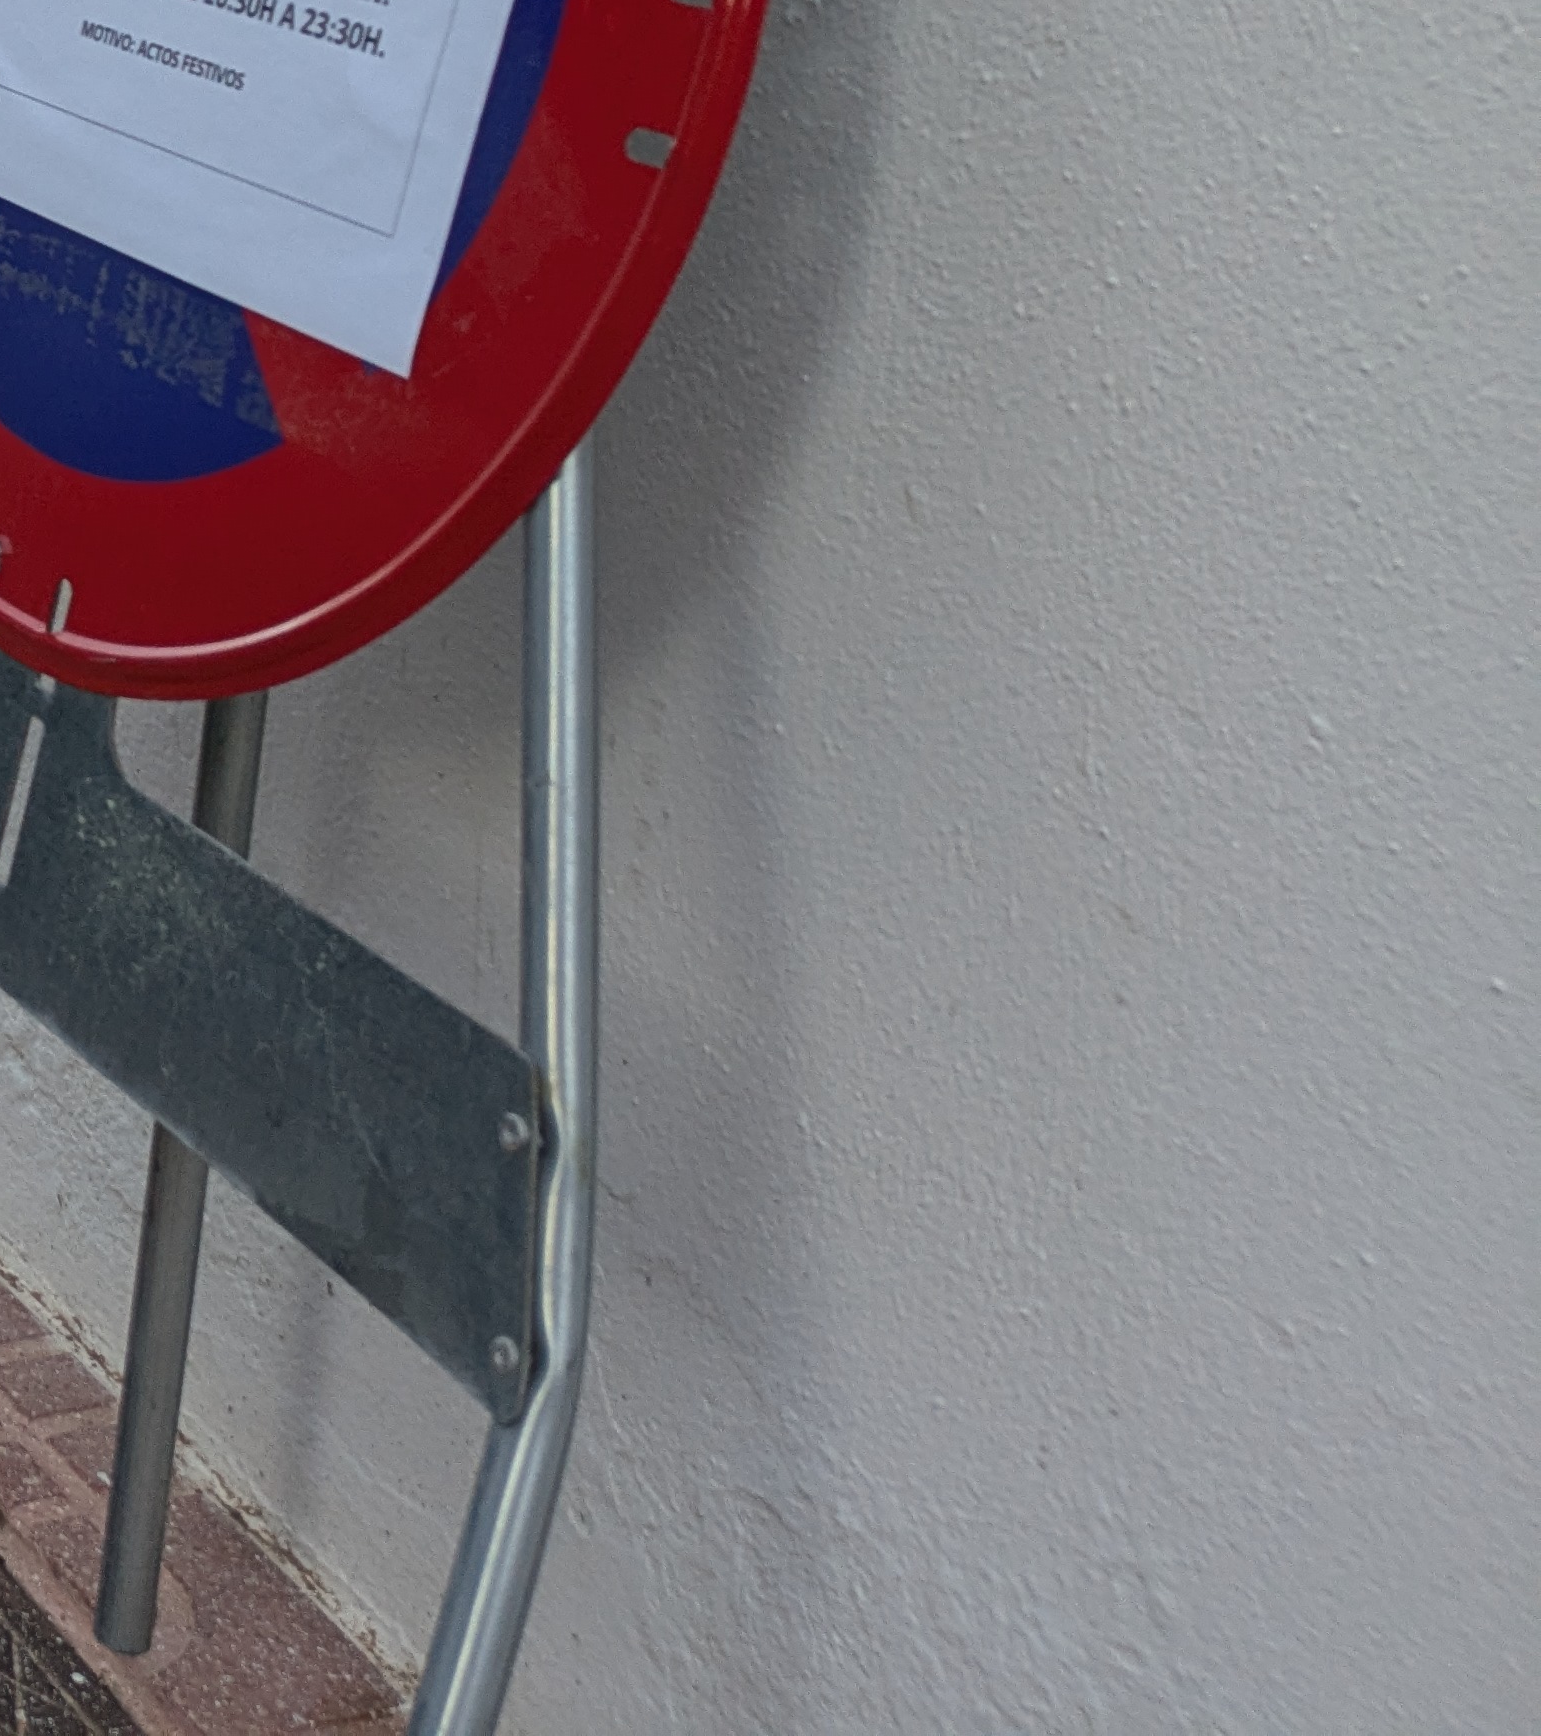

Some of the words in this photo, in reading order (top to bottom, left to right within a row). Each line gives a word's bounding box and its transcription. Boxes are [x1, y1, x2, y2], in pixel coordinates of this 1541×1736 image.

[80, 19, 136, 54] MOTIVO:
[136, 39, 181, 69] ACTOS
[181, 54, 245, 91] FESTIVOS
[278, 1, 297, 30] A
[299, 7, 385, 58] 23:30H.
